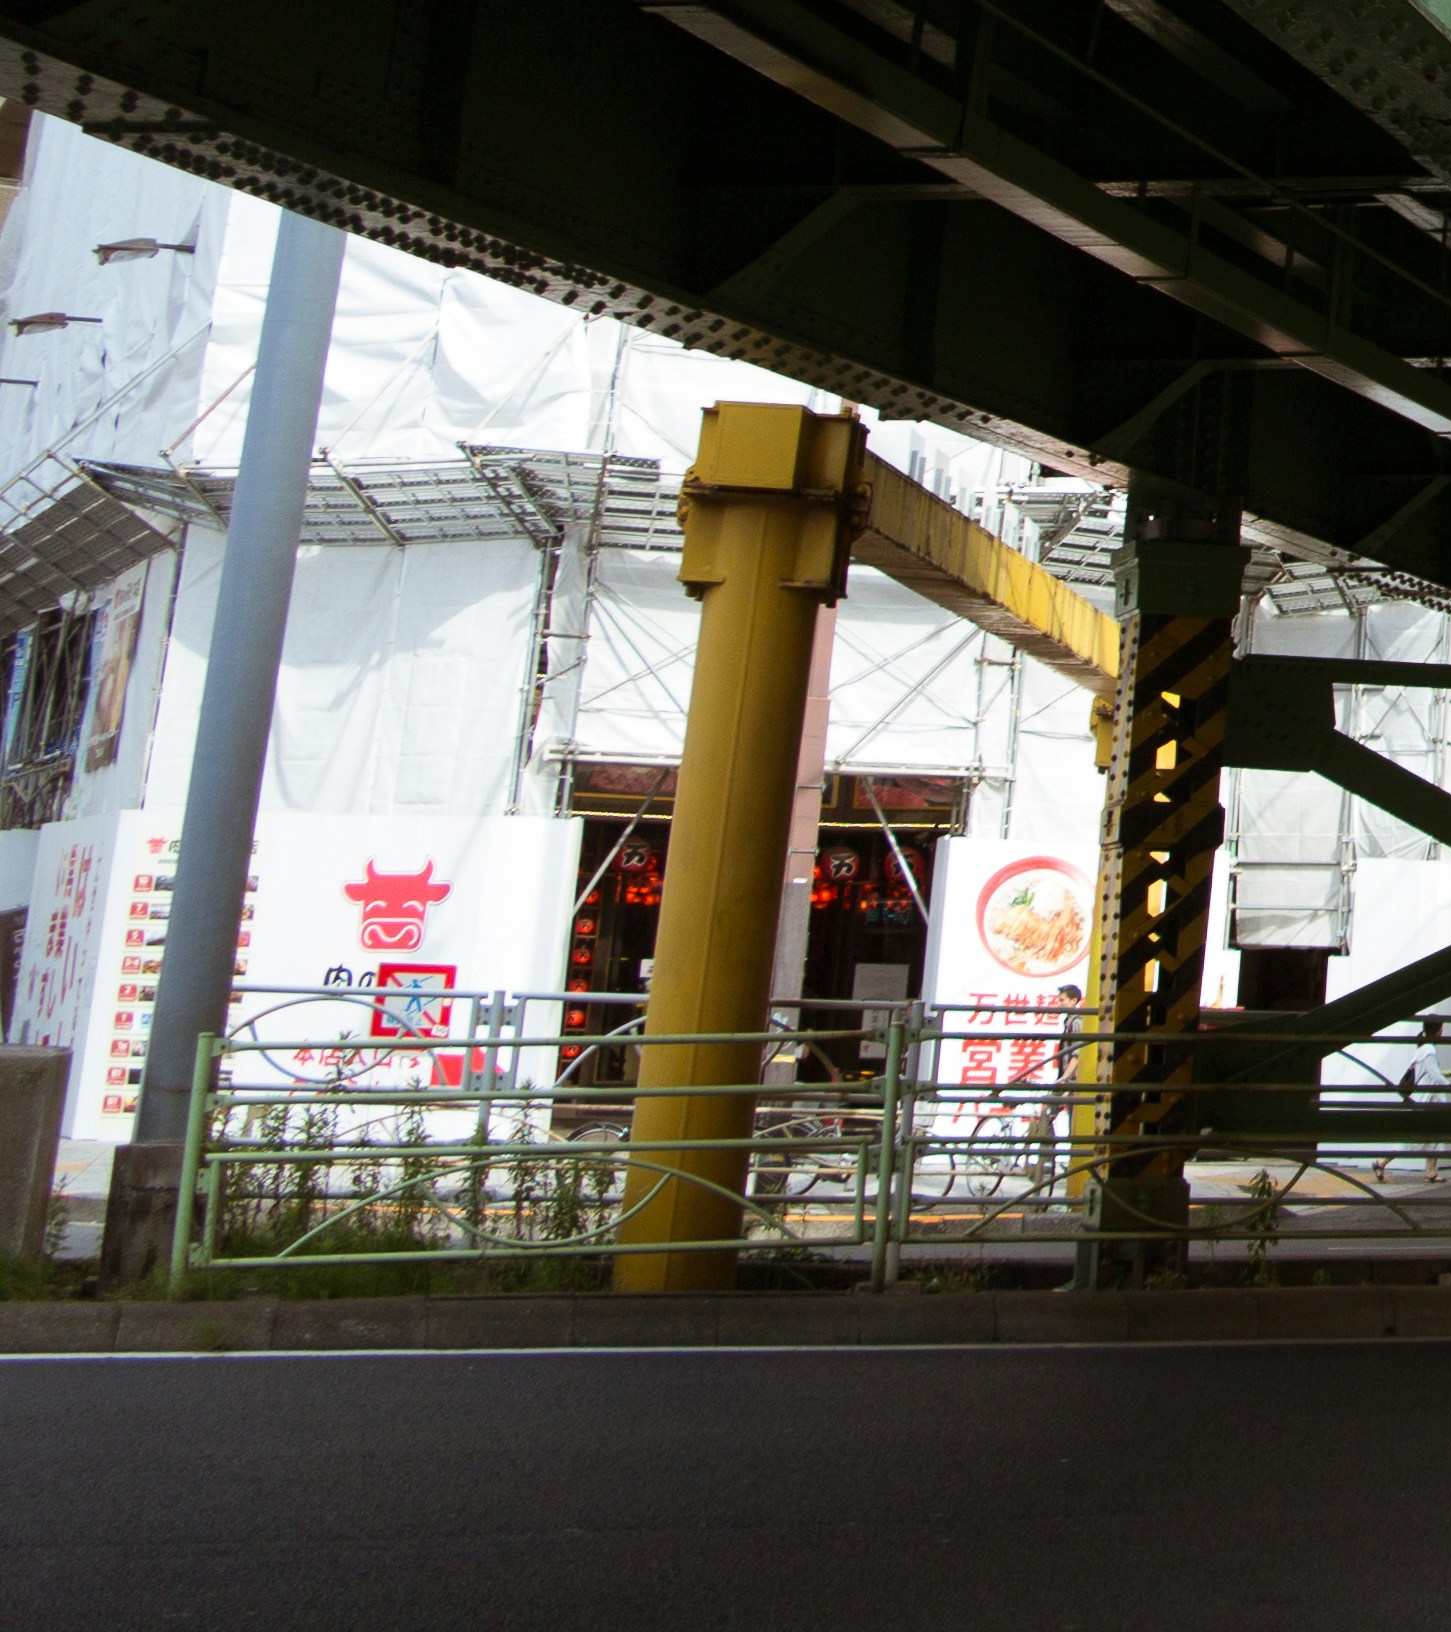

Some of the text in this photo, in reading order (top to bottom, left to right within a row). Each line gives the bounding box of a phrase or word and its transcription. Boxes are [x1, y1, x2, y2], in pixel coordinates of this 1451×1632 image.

[968, 993, 1086, 1026] 万世麺
[961, 1036, 1060, 1087] 営業
